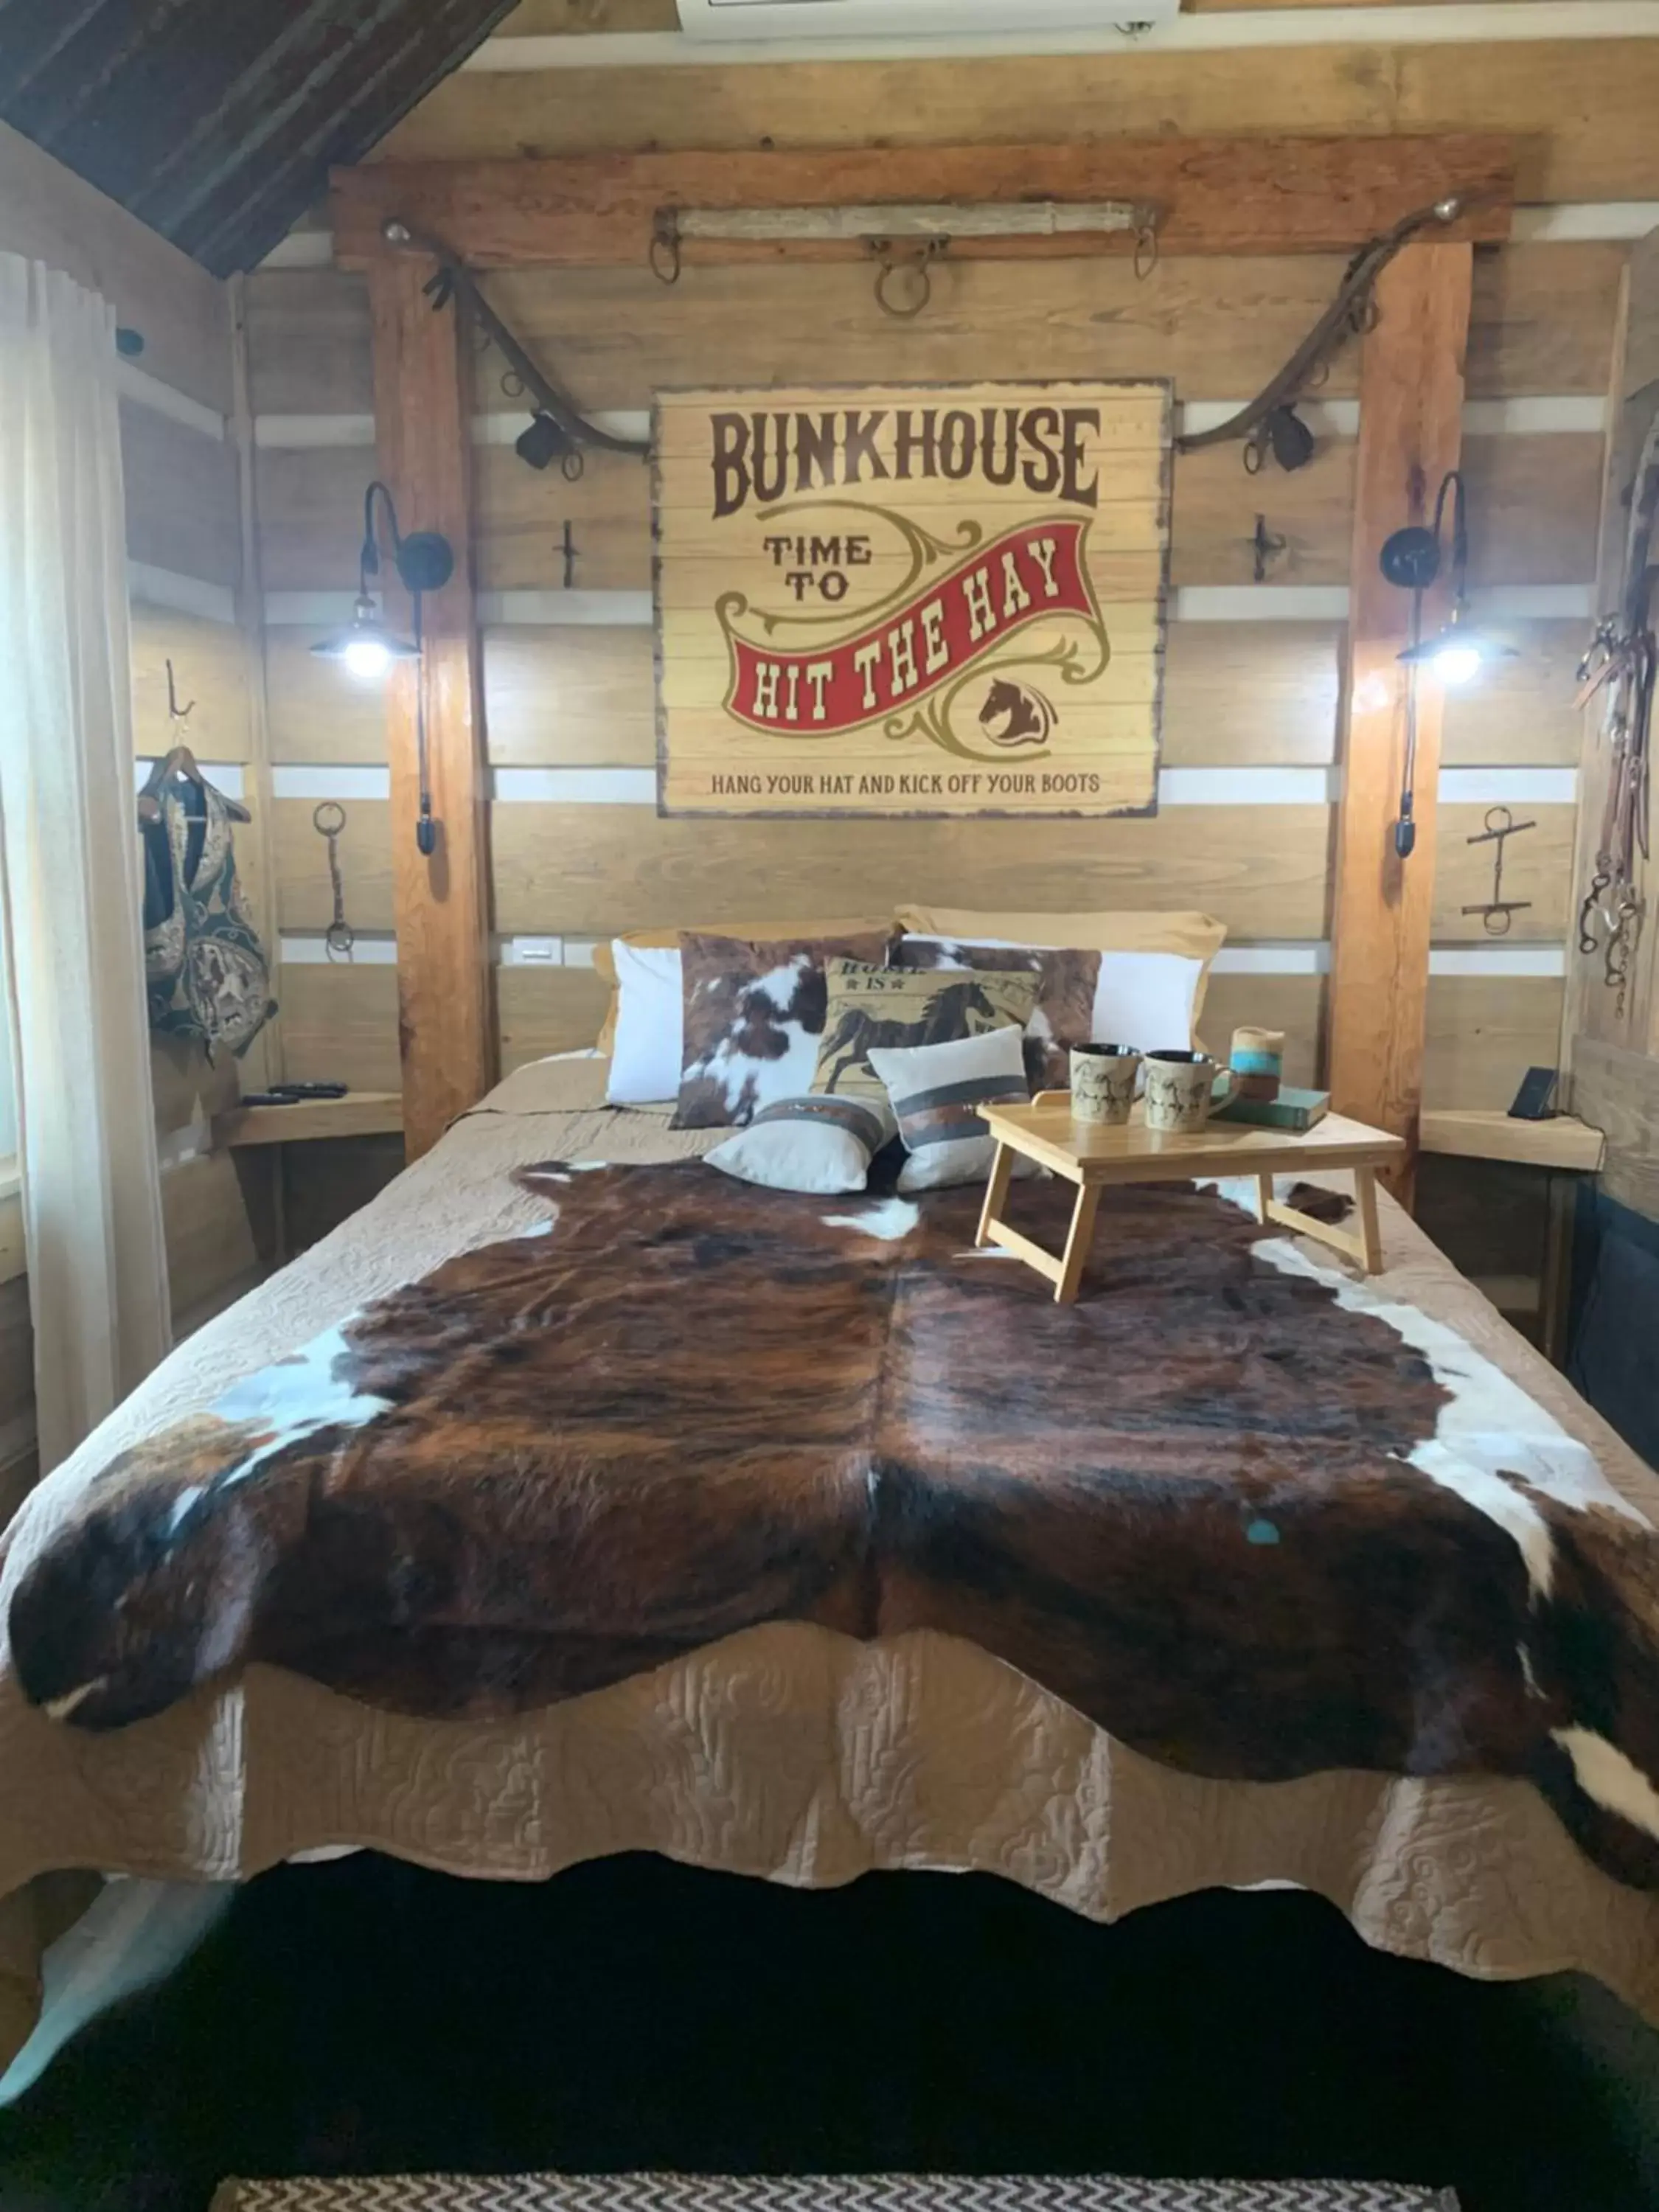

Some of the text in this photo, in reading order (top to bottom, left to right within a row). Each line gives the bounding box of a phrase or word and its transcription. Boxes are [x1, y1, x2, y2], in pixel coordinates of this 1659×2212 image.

[710, 407, 1101, 520] BUNKHOUSE
[762, 535, 872, 567] TIME
[785, 571, 849, 602] TO
[752, 538, 1059, 720] HIT THE HAY
[712, 773, 1100, 794] HANG YOUR HAT AND KICK OFF YOUR BOOTS
[866, 977, 886, 990] IS
